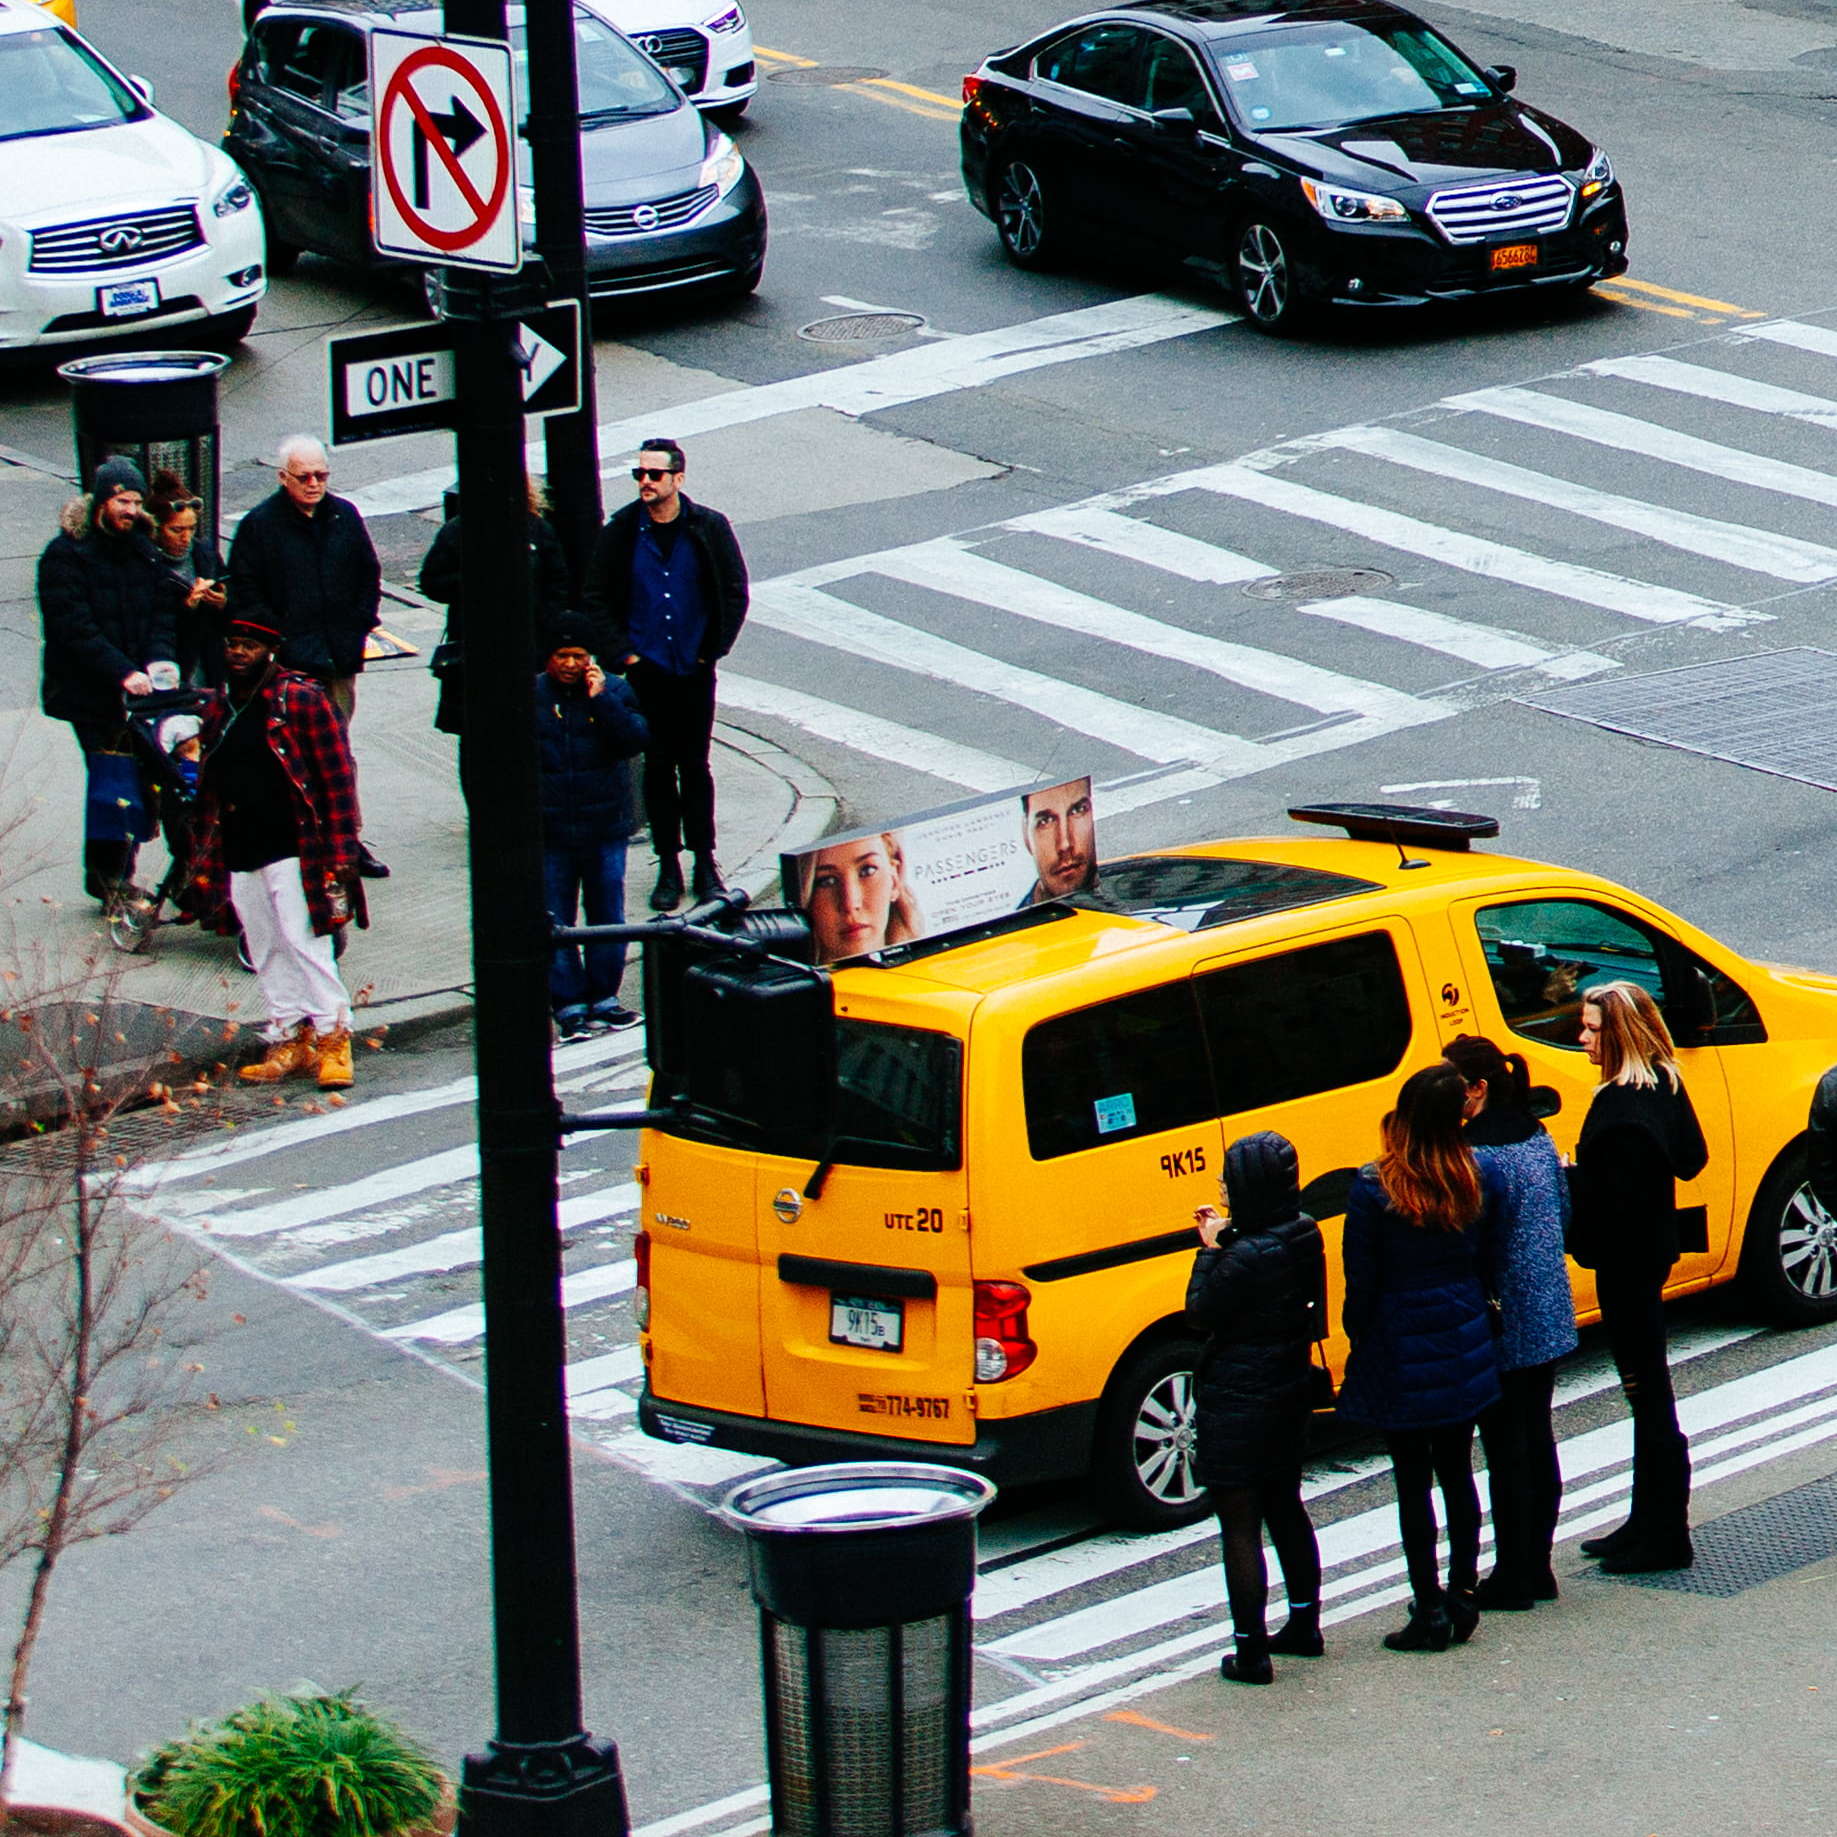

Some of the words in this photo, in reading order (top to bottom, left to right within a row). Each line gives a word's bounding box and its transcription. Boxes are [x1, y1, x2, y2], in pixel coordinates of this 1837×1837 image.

[367, 358, 438, 407] ONE
[915, 839, 1018, 880] PASSENGERS
[1160, 1146, 1206, 1179] 9K15
[884, 1212, 915, 1230] UTC
[916, 1207, 943, 1233] 20
[886, 1394, 949, 1419] 774-9767
